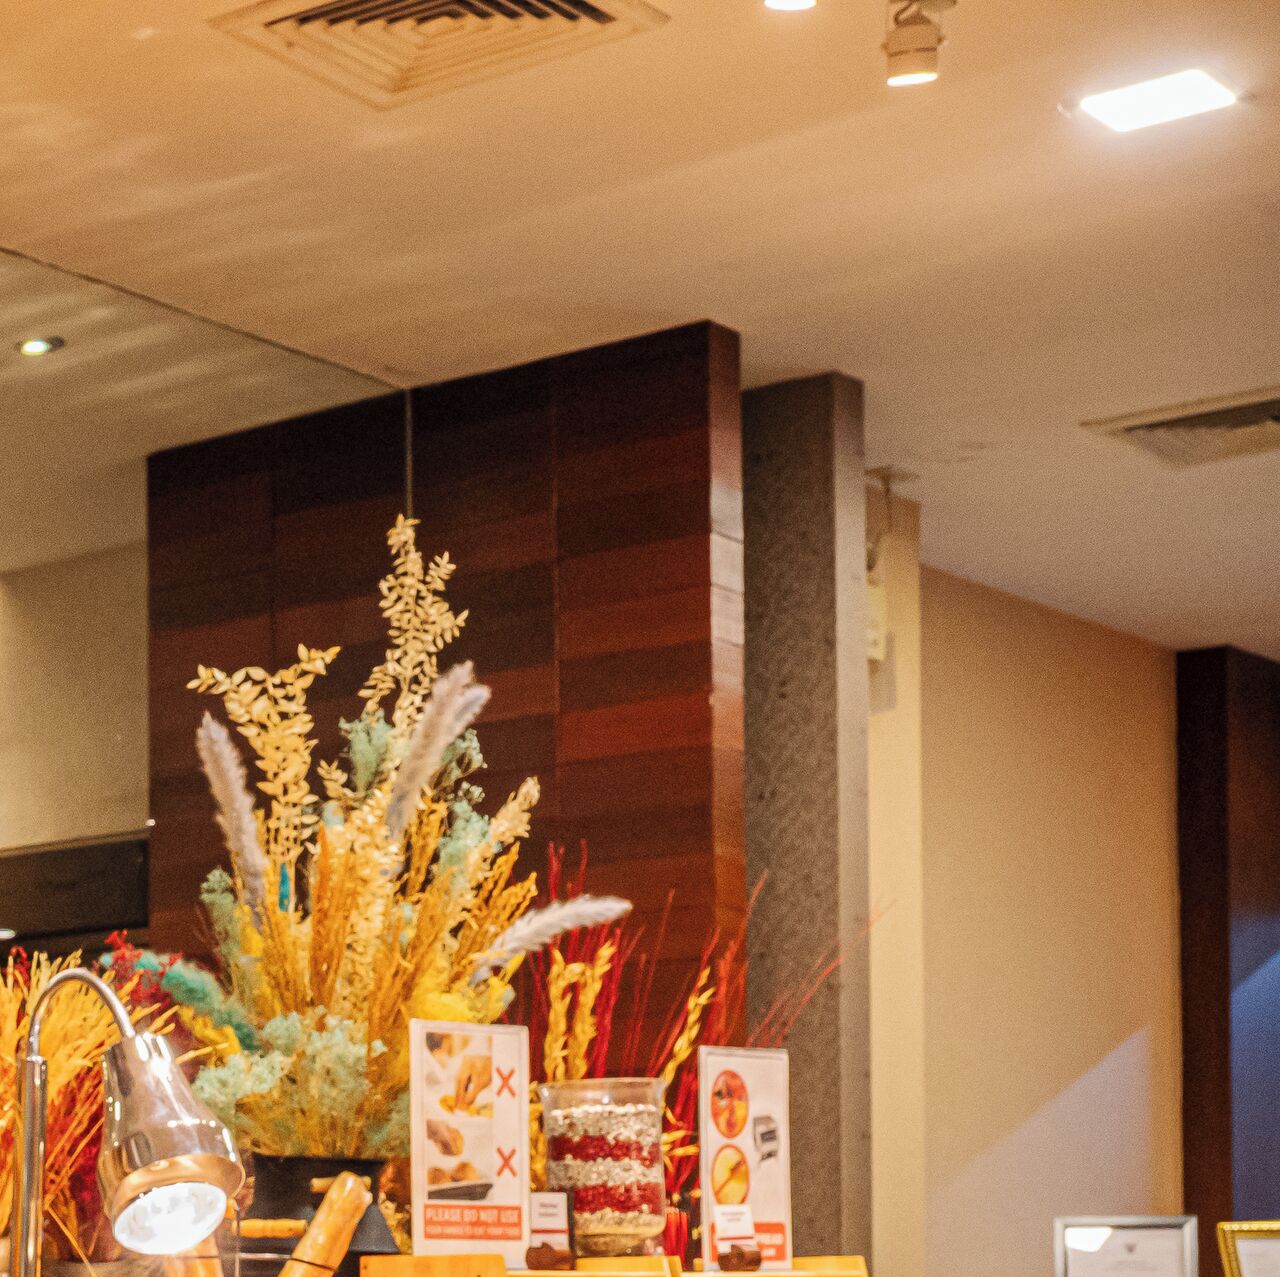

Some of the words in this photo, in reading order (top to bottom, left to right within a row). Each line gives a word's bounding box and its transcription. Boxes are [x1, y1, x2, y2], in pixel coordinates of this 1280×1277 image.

[425, 1207, 461, 1221] PLEASE
[463, 1208, 478, 1222] DO
[479, 1208, 499, 1223] NOT
[500, 1209, 518, 1223] USE
